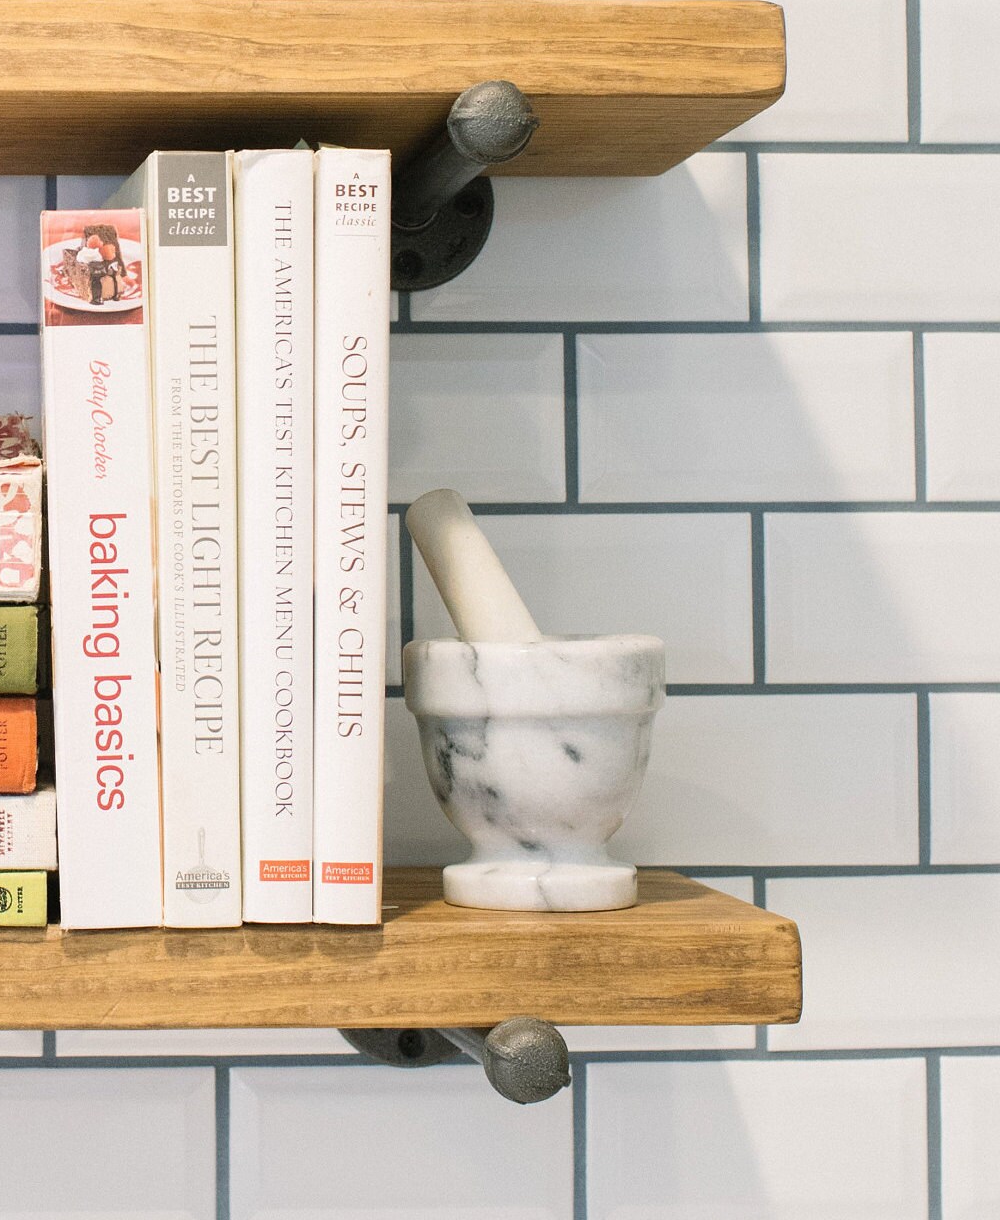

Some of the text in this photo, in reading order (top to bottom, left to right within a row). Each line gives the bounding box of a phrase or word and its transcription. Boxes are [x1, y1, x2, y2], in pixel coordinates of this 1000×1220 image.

[187, 174, 196, 183] A
[167, 187, 217, 204] BEST
[336, 185, 377, 197] BEST
[169, 207, 215, 219] RECIPE
[335, 202, 377, 212] RECIPE
[335, 214, 377, 227] classic
[169, 222, 215, 234] classic
[87, 361, 113, 479] Betty Crocker
[274, 201, 294, 816] THE AMERICA'S TEST KITCHEN MENU COOKBOOK
[170, 378, 186, 692] FROM THE EDITORS OF COOK'S ILLUSTRATED
[189, 315, 224, 755] THE BEST LIGHT RECIPE
[339, 336, 367, 737] SOUPS, STEWS & CHILIS
[83, 514, 134, 810] baking basics
[263, 863, 308, 873] America's
[326, 865, 371, 874] America's
[176, 872, 229, 881] America's
